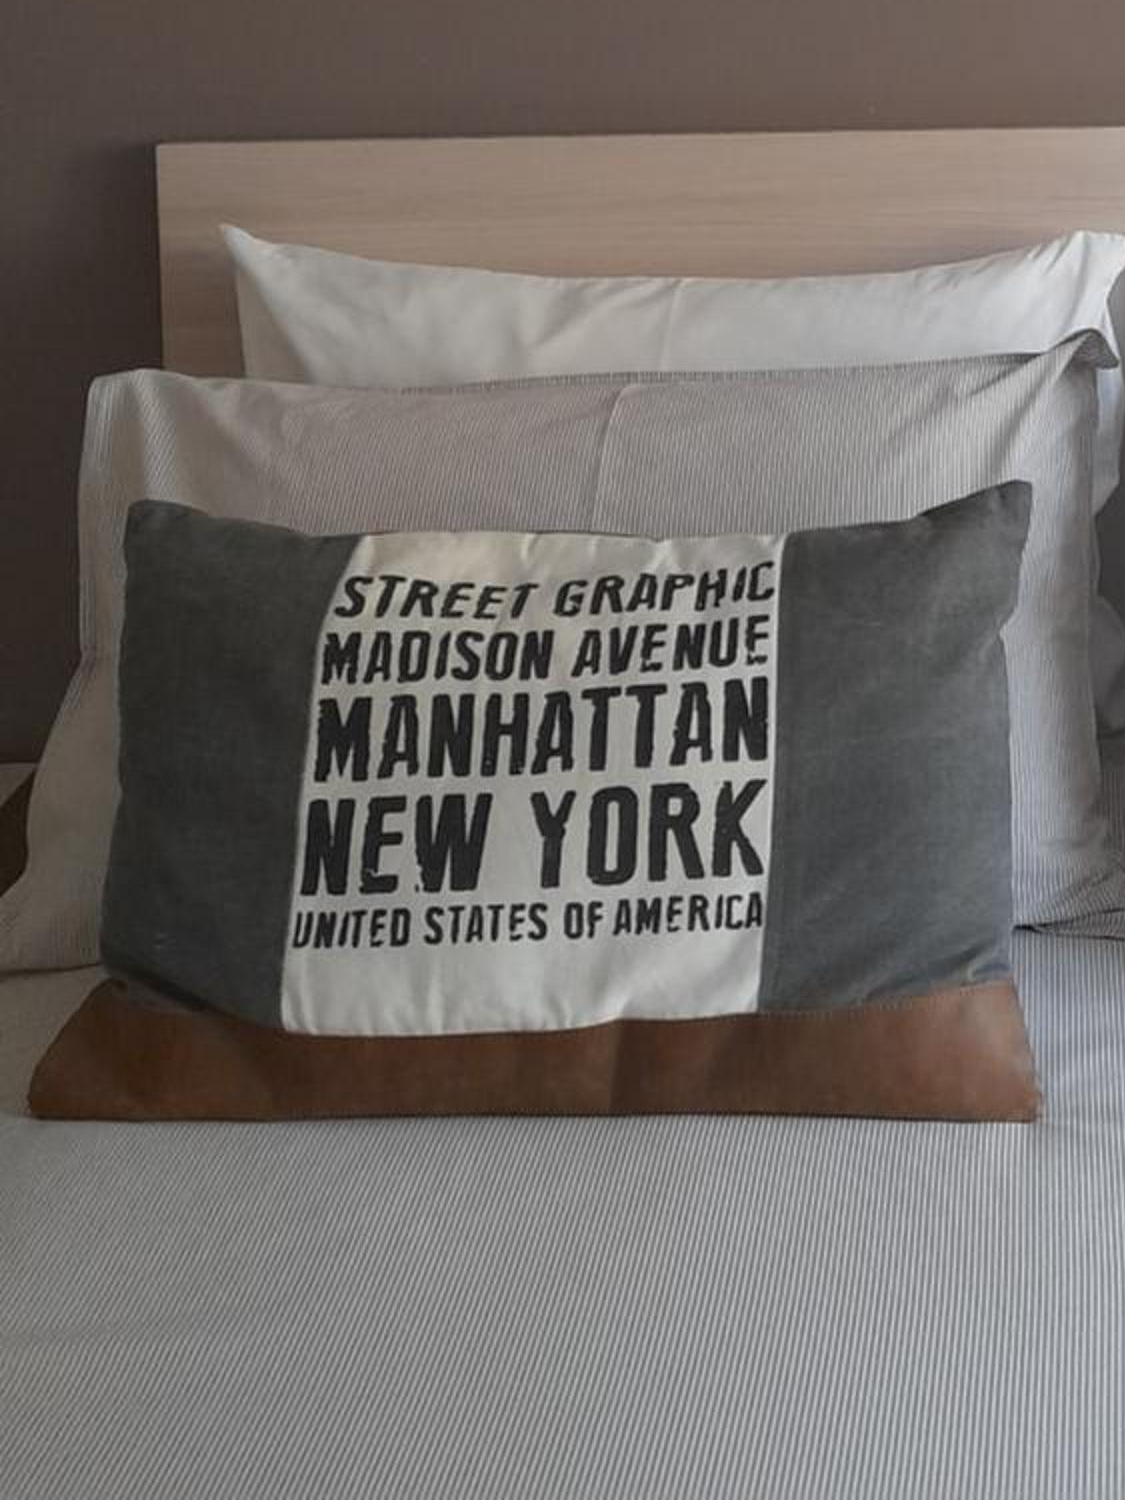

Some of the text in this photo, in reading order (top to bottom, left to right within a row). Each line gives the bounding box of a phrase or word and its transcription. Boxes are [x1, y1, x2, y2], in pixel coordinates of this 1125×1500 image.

[334, 560, 775, 620] STREET GRAPHIC
[320, 614, 770, 685] MADISON AVENUE
[314, 676, 769, 783] MANHATTAN
[300, 778, 768, 897] NEW YORK
[292, 892, 764, 950] UNITED STATES OF AMERICA
